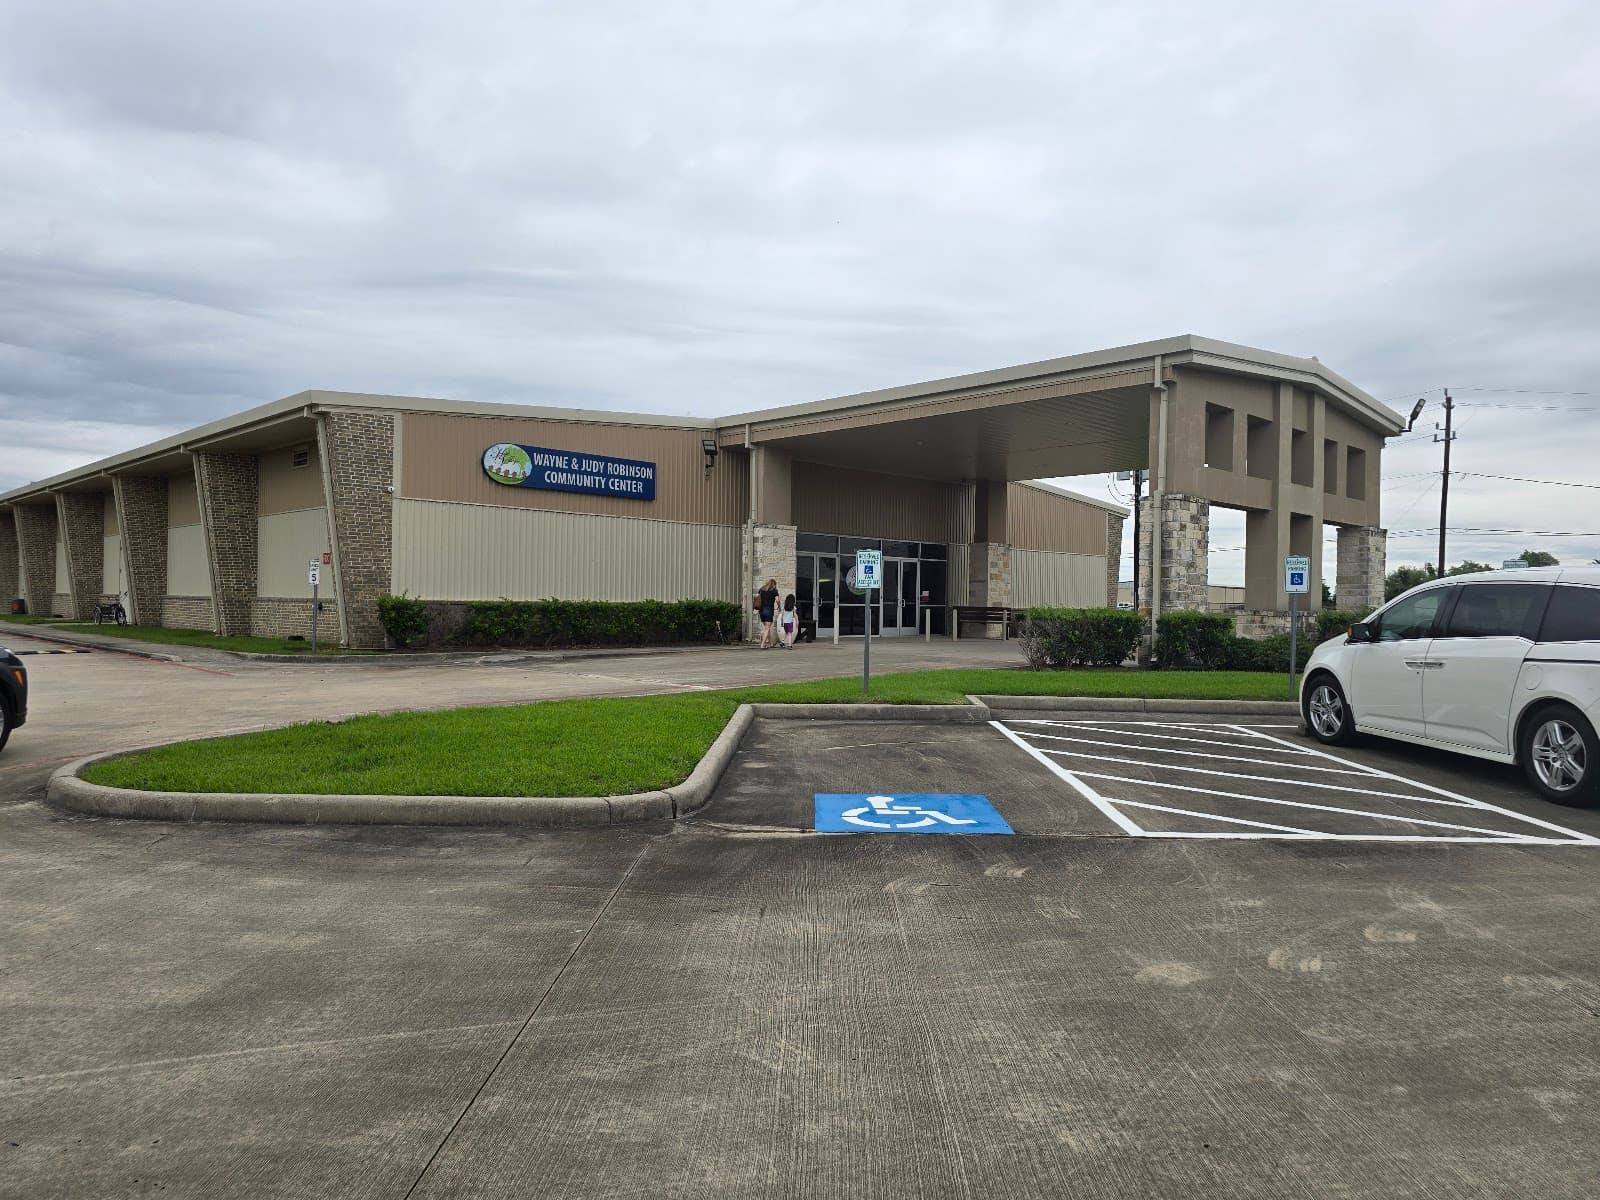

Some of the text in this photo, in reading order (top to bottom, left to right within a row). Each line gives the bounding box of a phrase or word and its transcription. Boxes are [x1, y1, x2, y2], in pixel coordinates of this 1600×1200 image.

[533, 452, 653, 480] WAYNE & JUDY ROBINSON
[544, 470, 643, 494] COMMUNITY CENTER
[311, 573, 317, 582] 5
